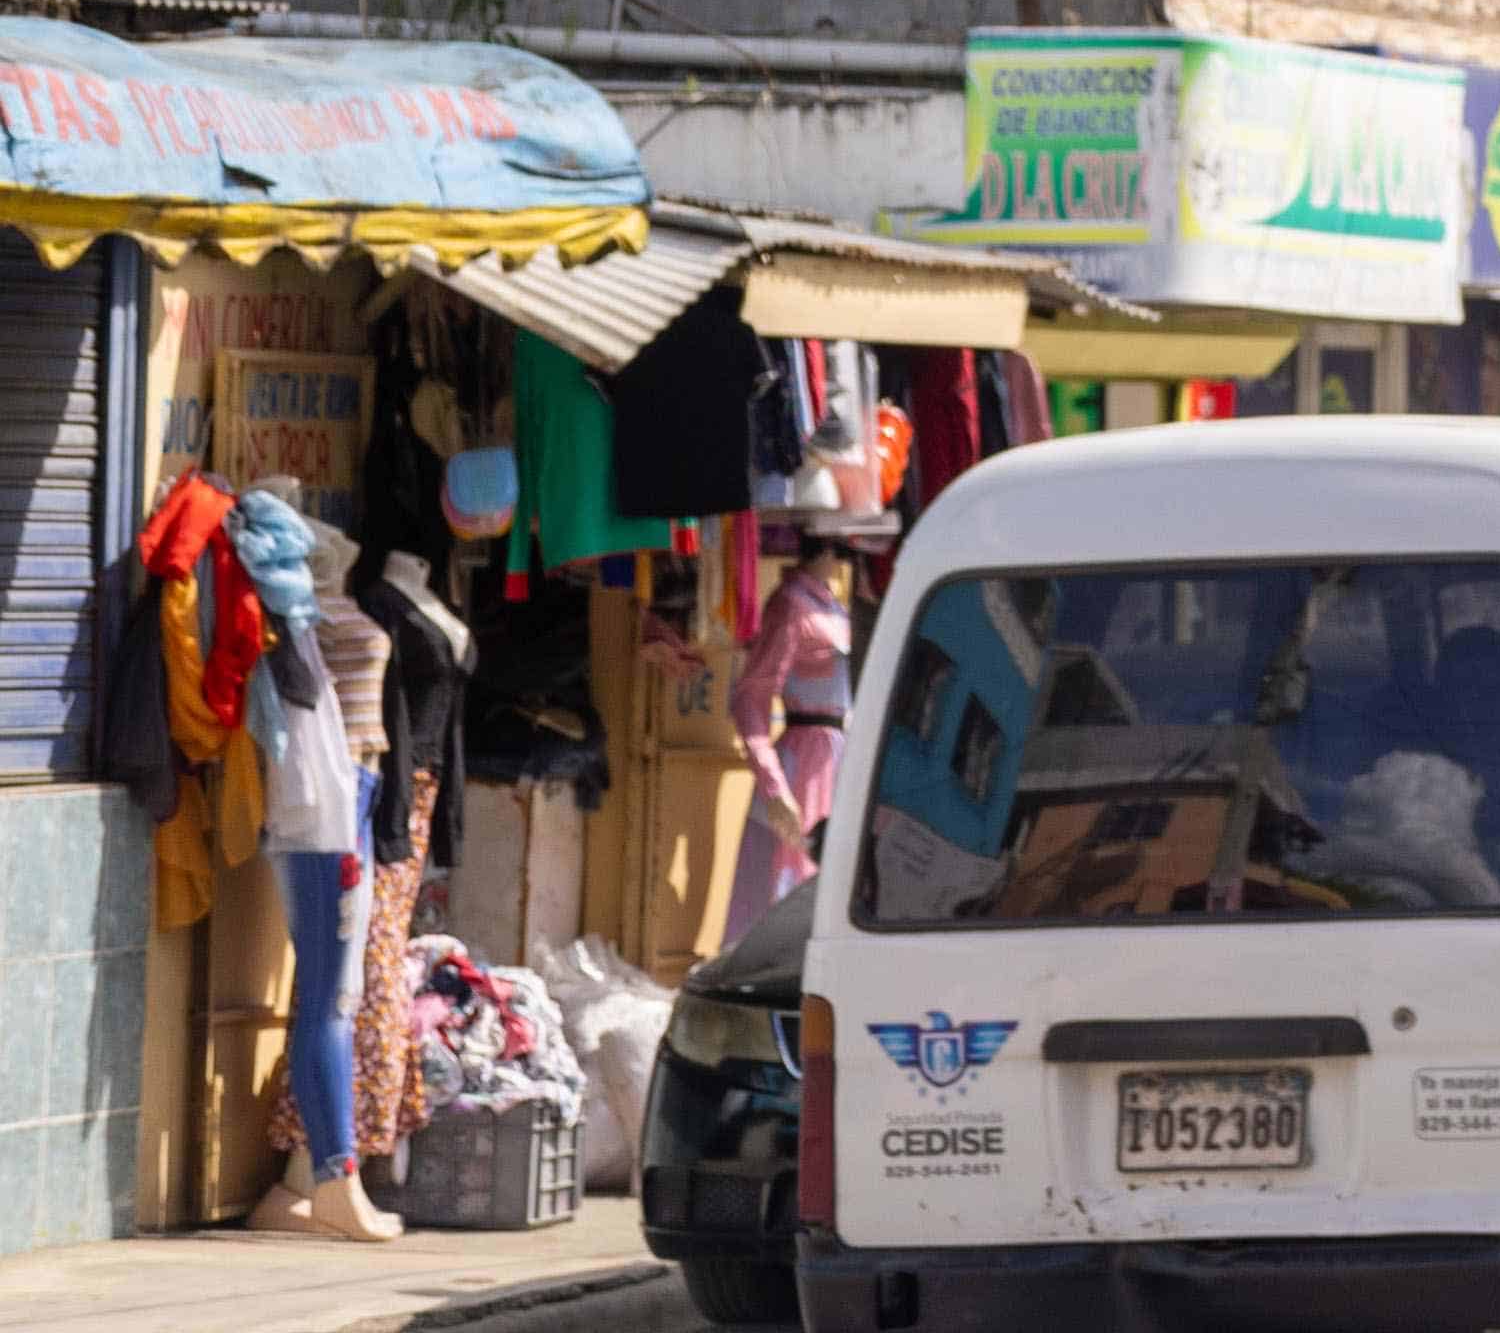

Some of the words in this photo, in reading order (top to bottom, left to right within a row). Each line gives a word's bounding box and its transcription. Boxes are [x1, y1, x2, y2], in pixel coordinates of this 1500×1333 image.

[1013, 151, 1057, 220] LA
[1063, 150, 1150, 220] CRUZ
[882, 1126, 1006, 1158] CEDISE
